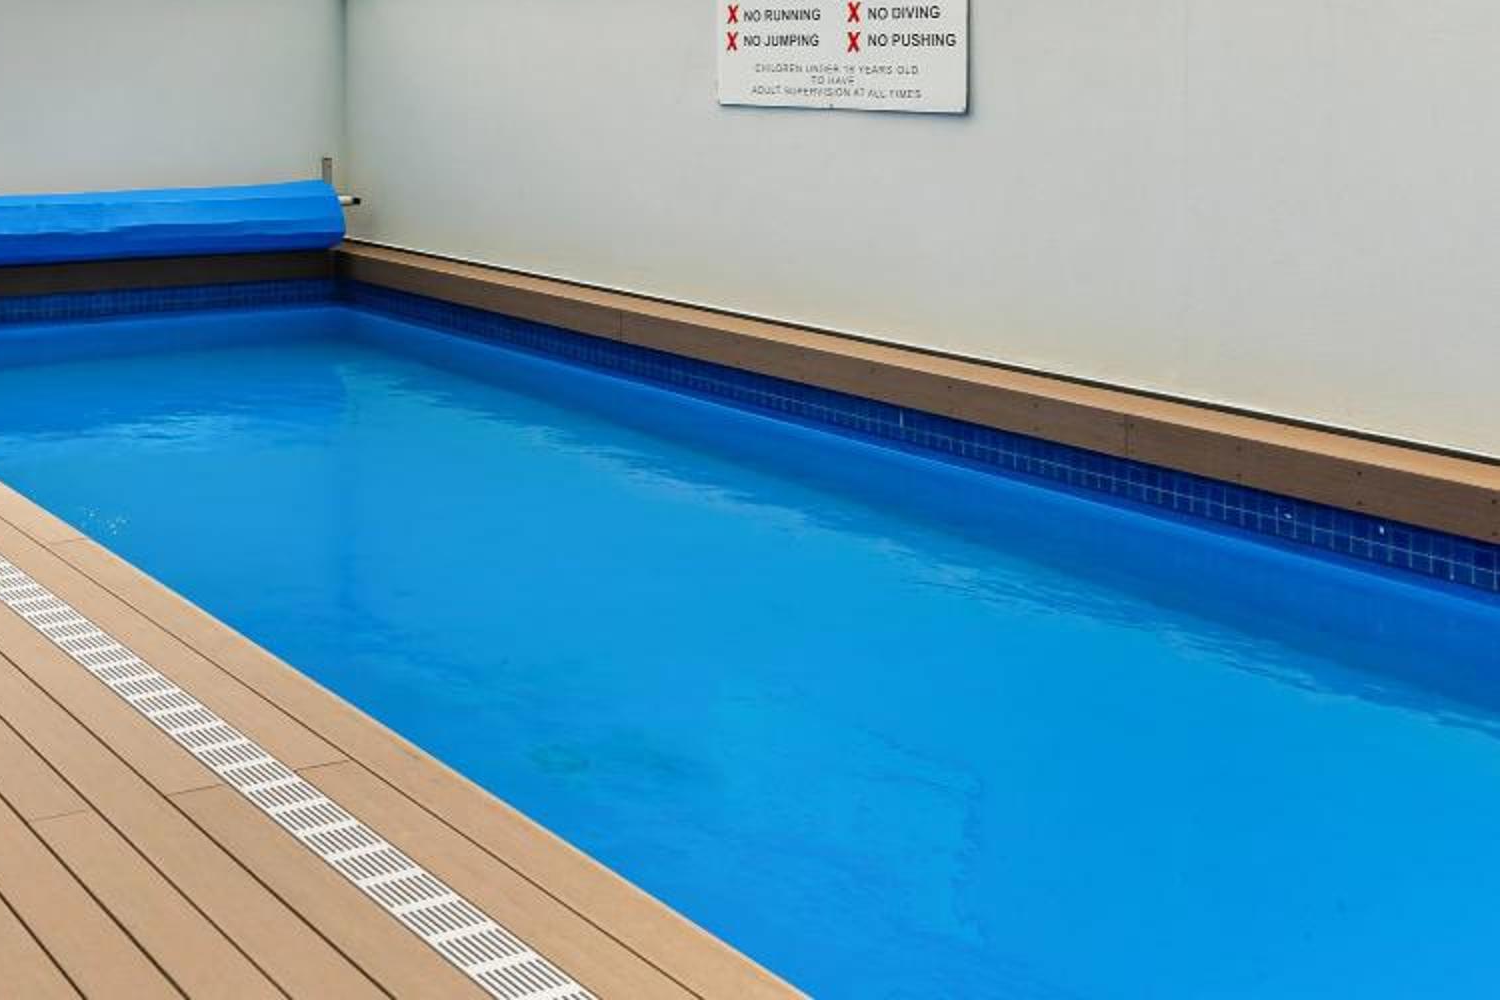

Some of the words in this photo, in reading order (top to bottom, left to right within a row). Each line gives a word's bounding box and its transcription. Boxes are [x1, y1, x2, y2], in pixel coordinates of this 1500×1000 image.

[743, 10, 761, 22] NO
[765, 9, 821, 21] RUNNING
[867, 7, 888, 20] NO
[892, 6, 940, 19] DIVING
[743, 35, 761, 47] NO
[765, 34, 820, 47] JUMPING
[867, 34, 888, 47] NO
[892, 34, 957, 47] PUSHING
[755, 63, 803, 73] CHILDREN
[858, 65, 893, 75] YEARS
[896, 65, 919, 75] OLD
[811, 75, 825, 85] TO
[752, 85, 781, 95] ADULT
[853, 87, 865, 97] AT
[867, 88, 886, 99] ALL
[889, 89, 922, 99] TIMES
